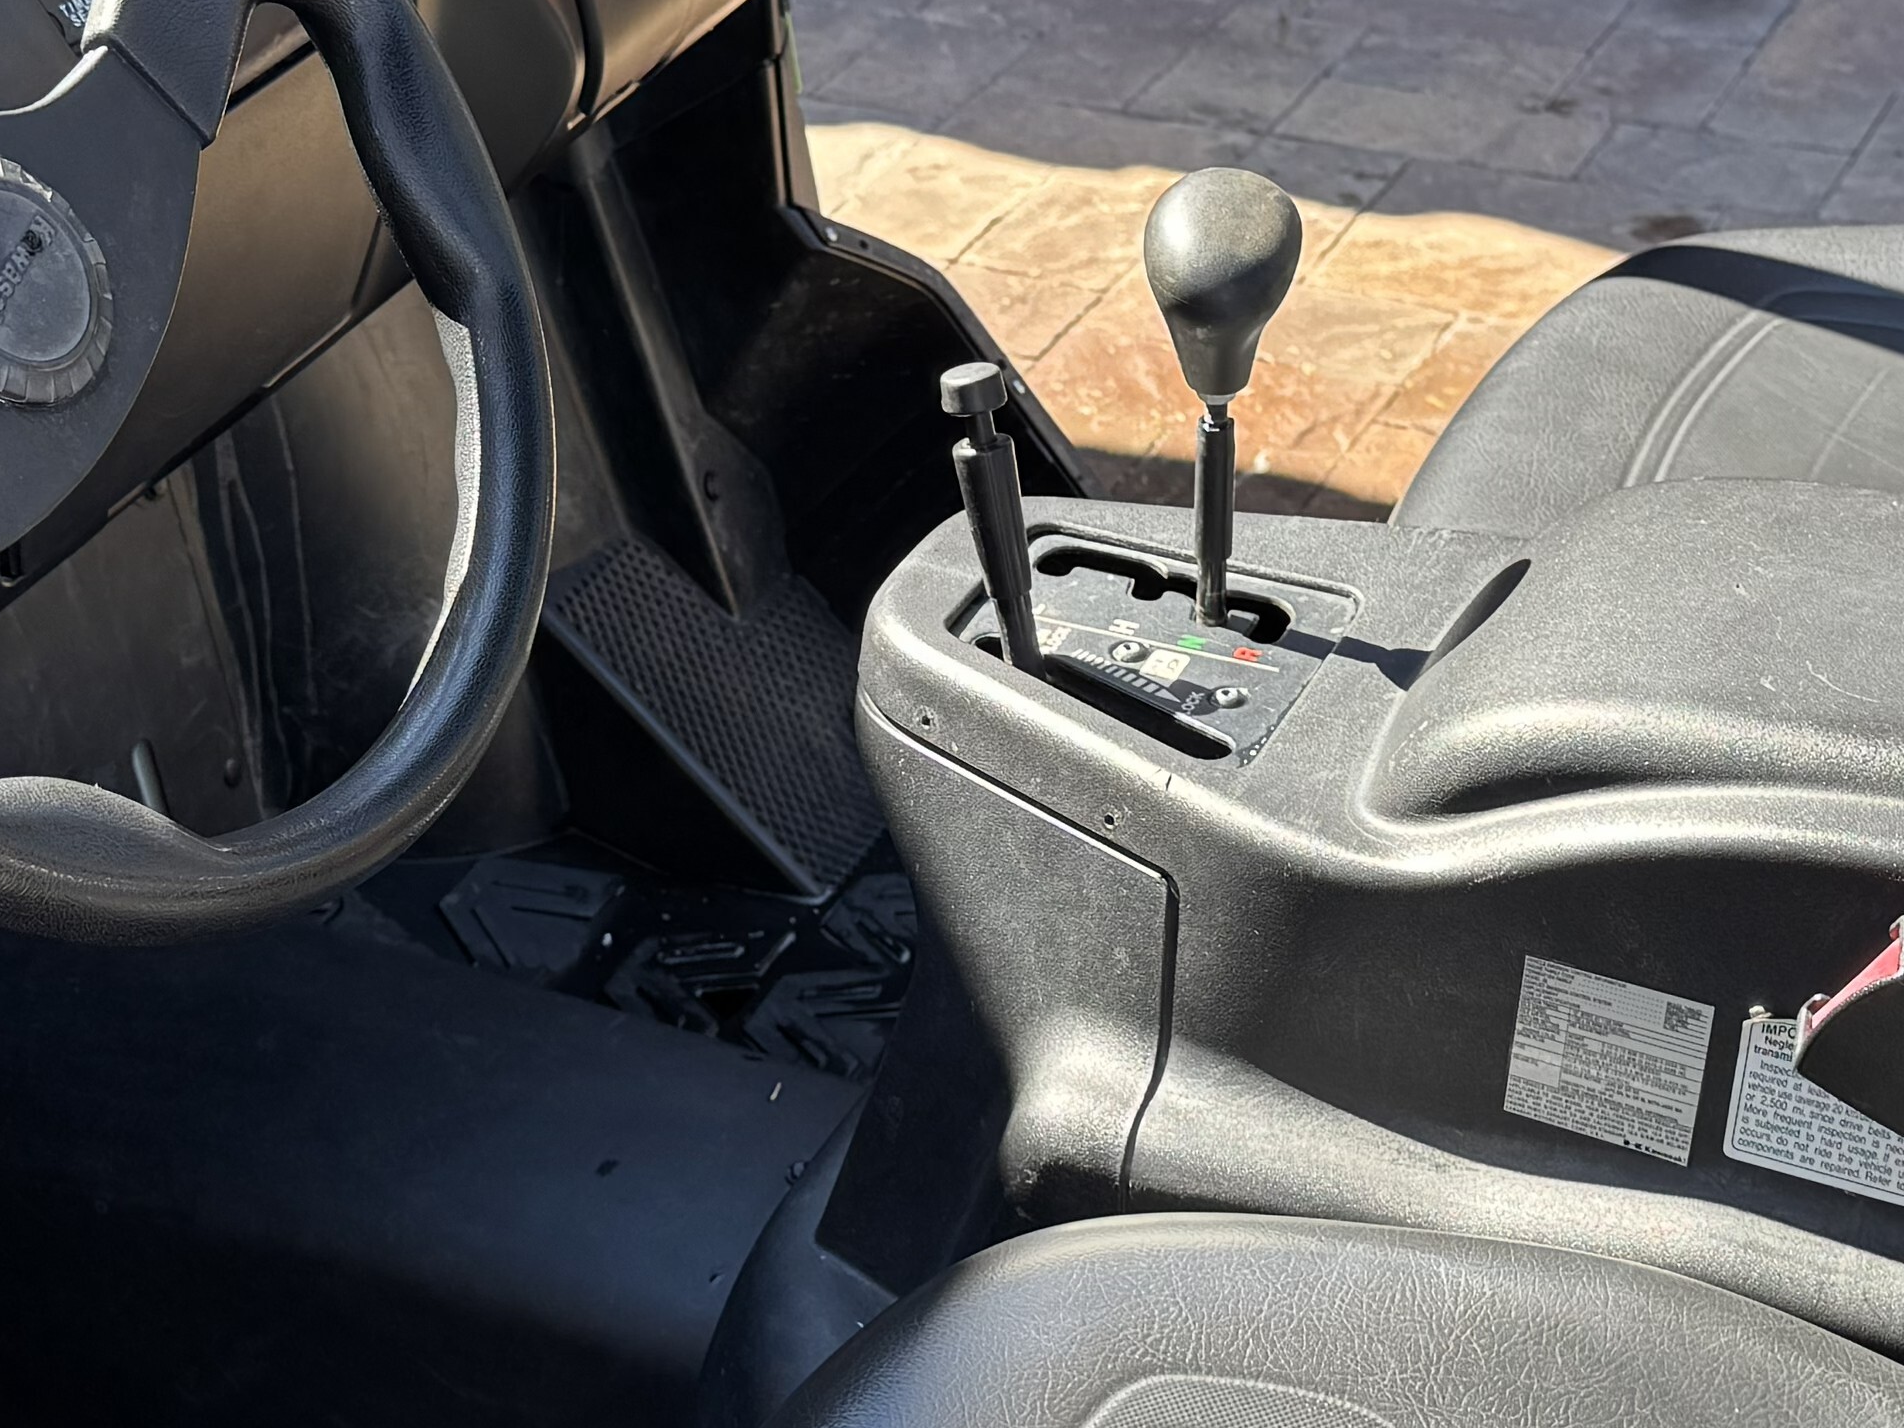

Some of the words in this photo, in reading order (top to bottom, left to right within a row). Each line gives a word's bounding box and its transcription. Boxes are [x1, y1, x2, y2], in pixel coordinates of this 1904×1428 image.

[1749, 1071, 1788, 1088] required
[1744, 1103, 1768, 1118] More
[1773, 1110, 1813, 1128] frequent
[1817, 1121, 1867, 1144] inspection
[1809, 1110, 1835, 1124] since
[1755, 1118, 1801, 1138] subjected
[1806, 1132, 1815, 1142] to
[1820, 1135, 1842, 1149] hard
[1737, 1137, 1794, 1160] components
[1799, 1155, 1815, 1165] are
[1776, 1136, 1789, 1147] do
[1793, 1142, 1809, 1152] not
[1814, 1146, 1833, 1159] ride
[1838, 1152, 1853, 1165] the
[1859, 1159, 1893, 1176] vehicle
